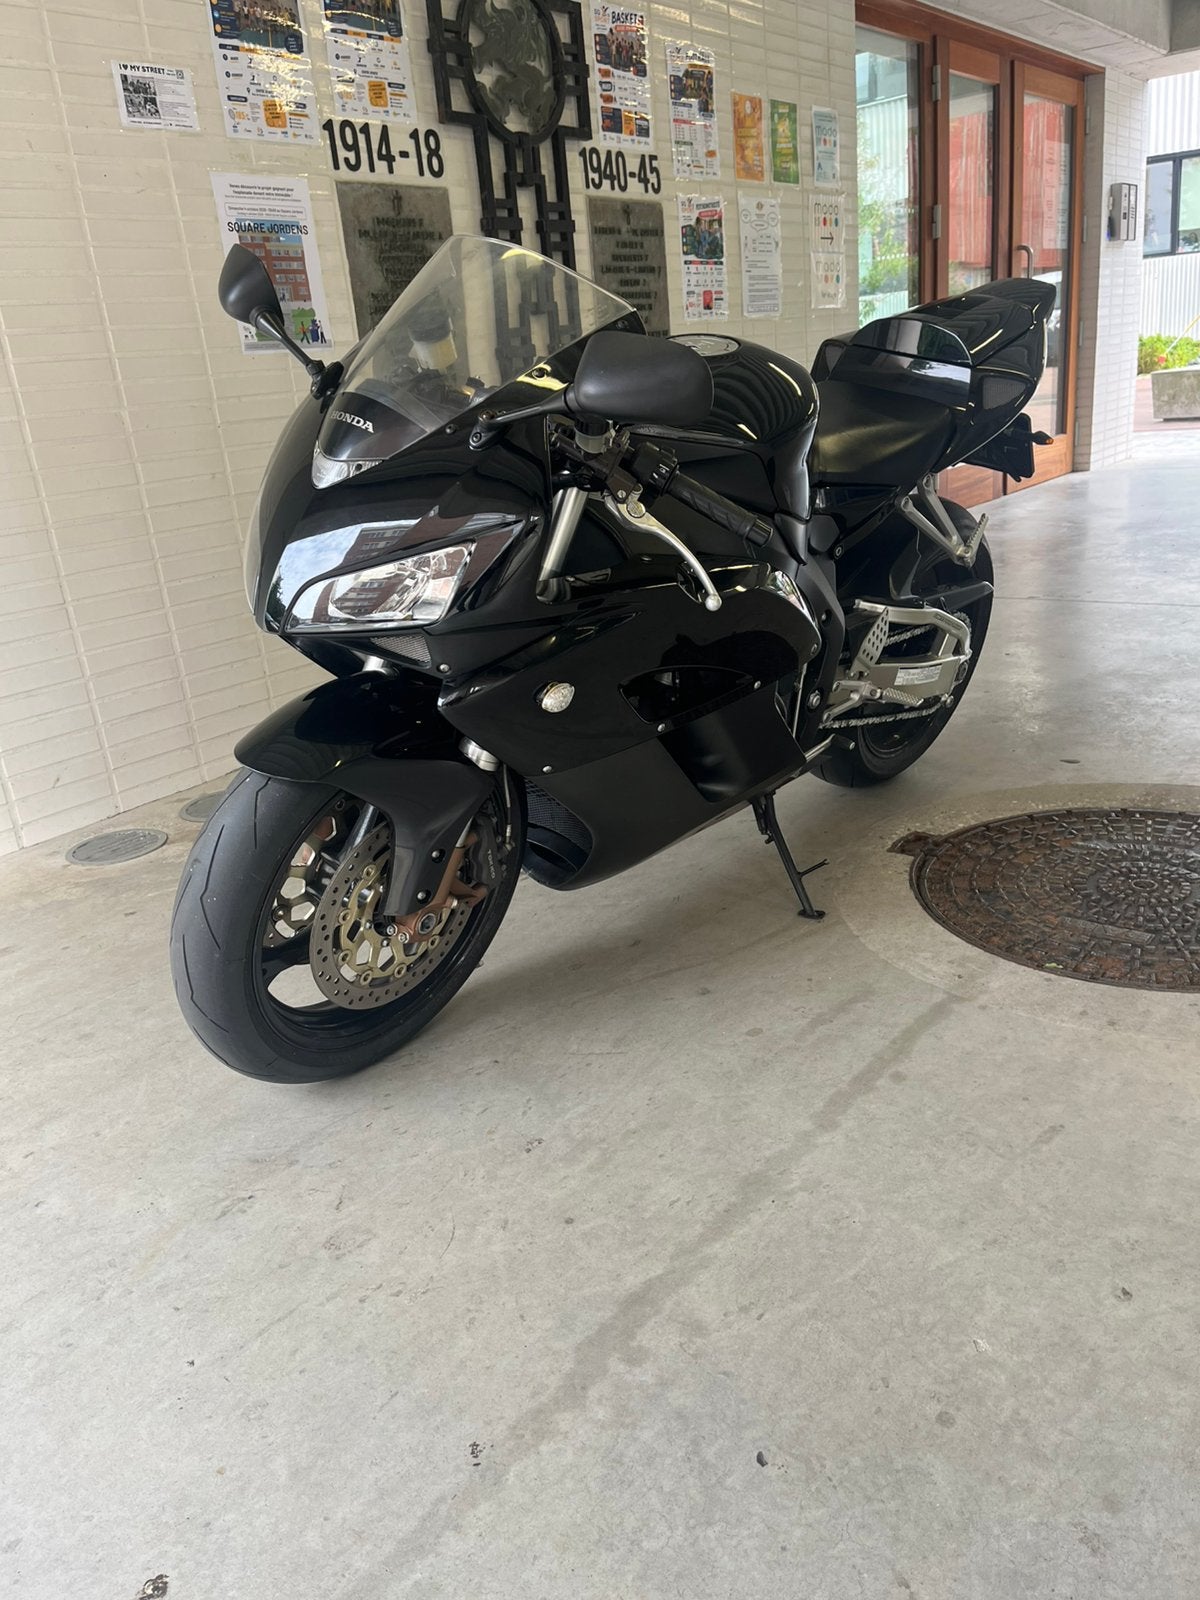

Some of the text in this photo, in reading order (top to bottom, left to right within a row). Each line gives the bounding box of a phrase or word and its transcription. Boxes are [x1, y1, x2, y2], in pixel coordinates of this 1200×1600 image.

[141, 66, 165, 75] STREET
[322, 118, 444, 178] 1914-18
[578, 146, 661, 194] 1940-45
[227, 221, 309, 235] SQUARE JORDENS
[330, 410, 374, 433] HONDA
